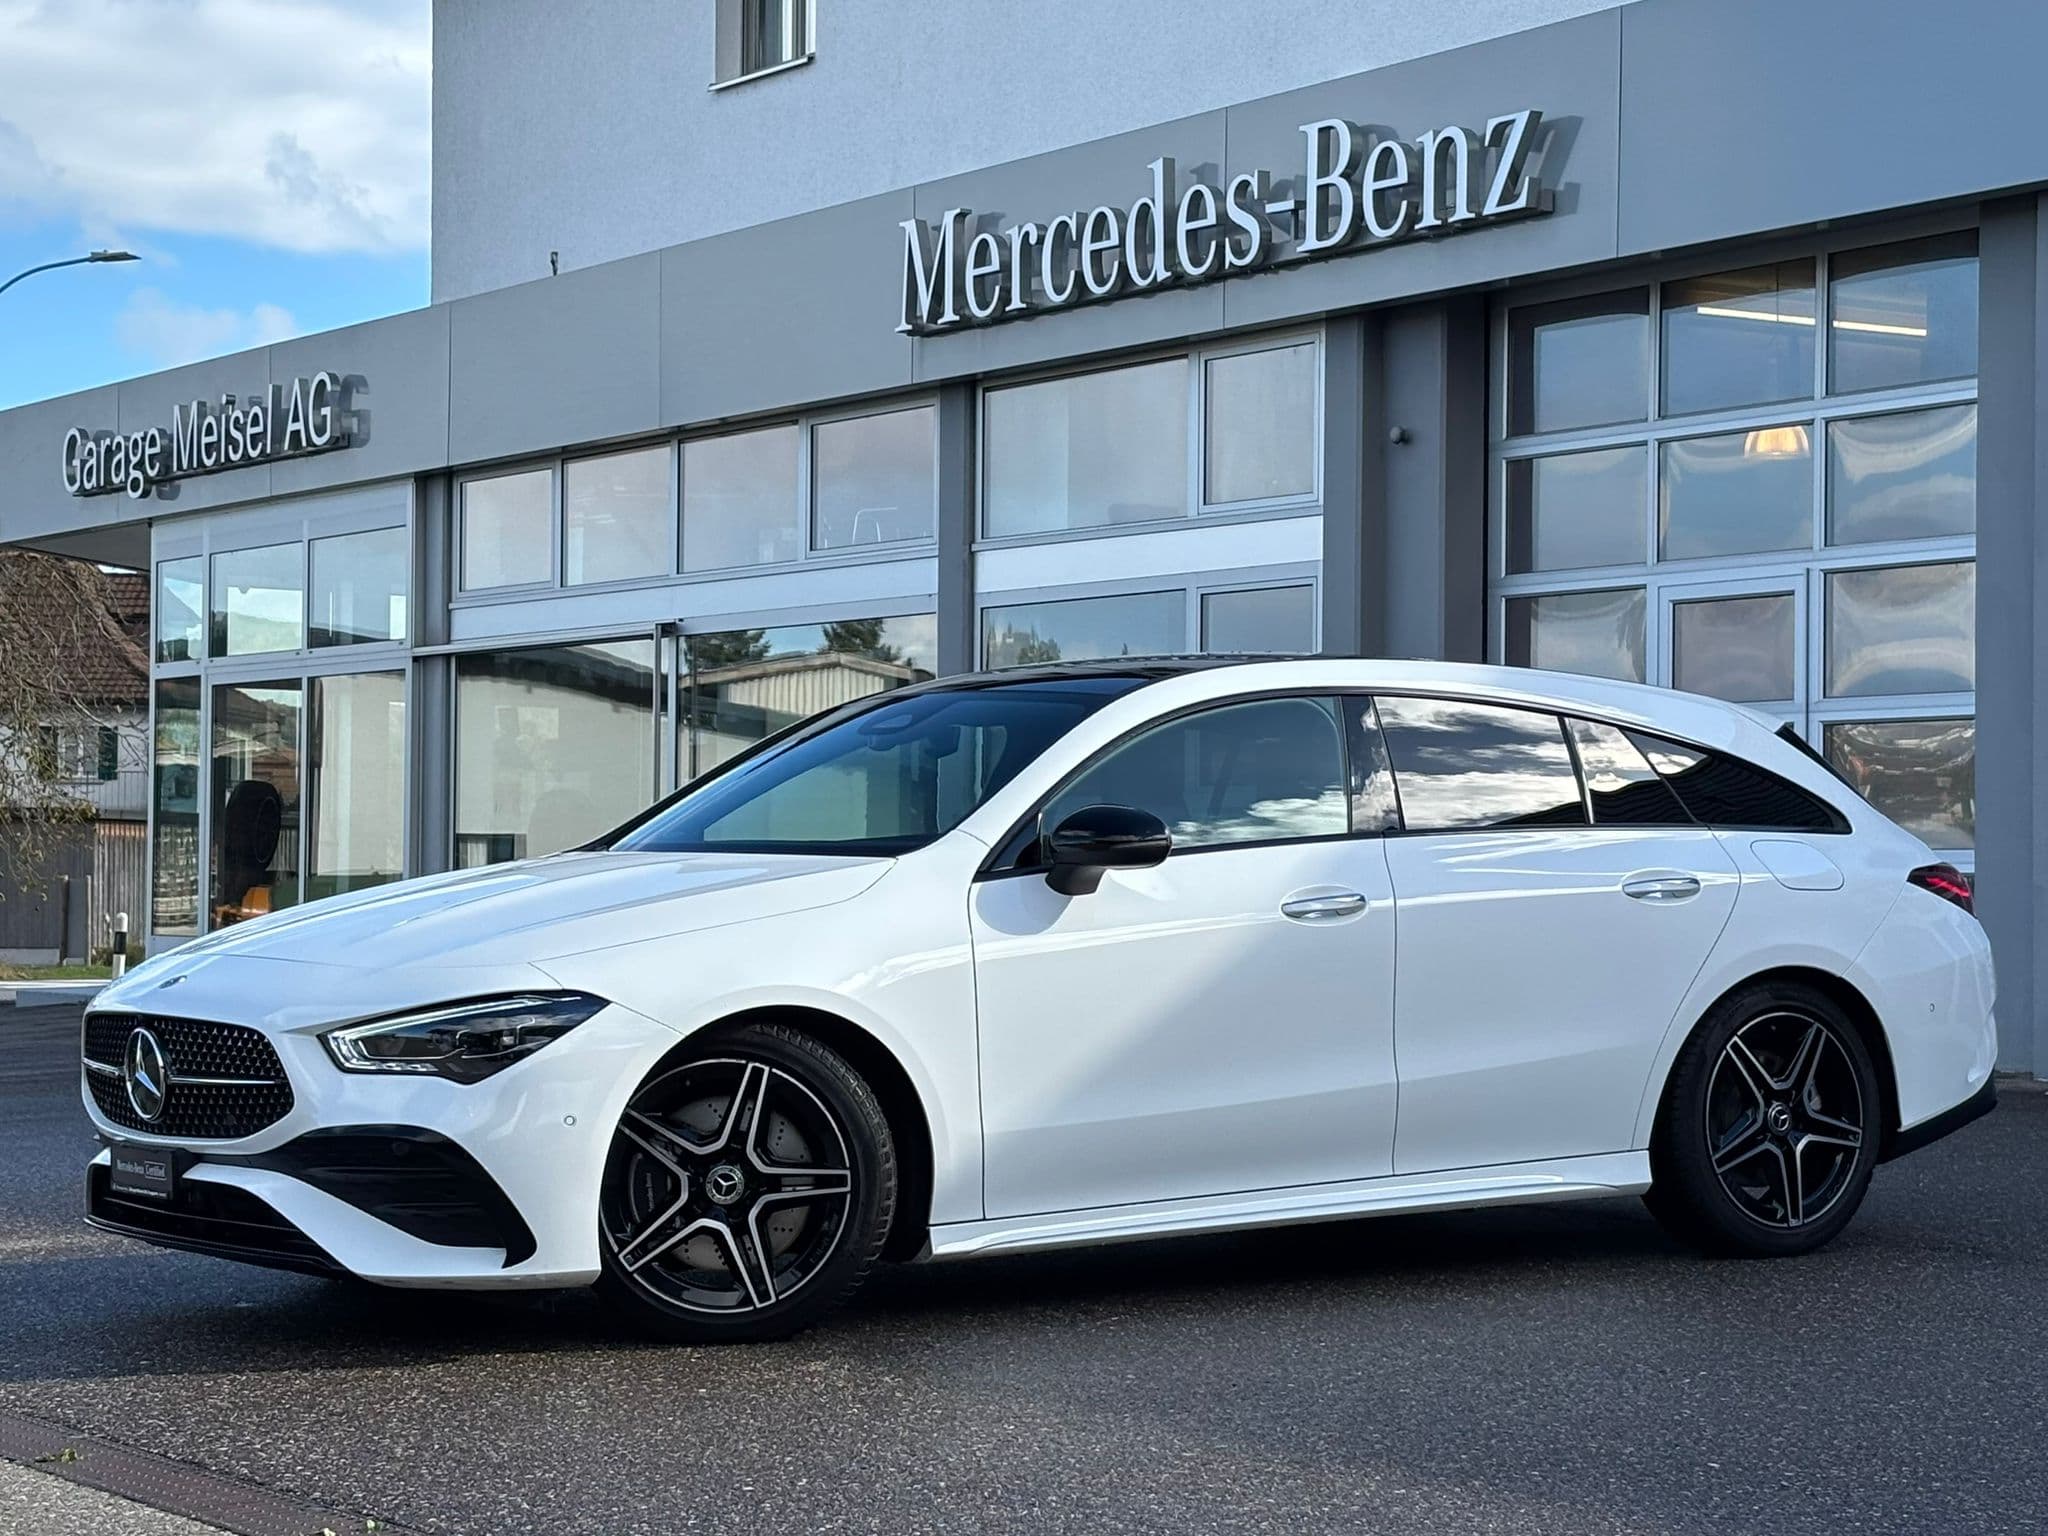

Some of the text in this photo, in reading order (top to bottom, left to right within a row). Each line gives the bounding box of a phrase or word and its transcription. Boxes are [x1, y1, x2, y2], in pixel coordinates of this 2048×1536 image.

[894, 109, 1543, 334] Mercedes-Benz
[62, 371, 333, 499] Garage Meisel AG
